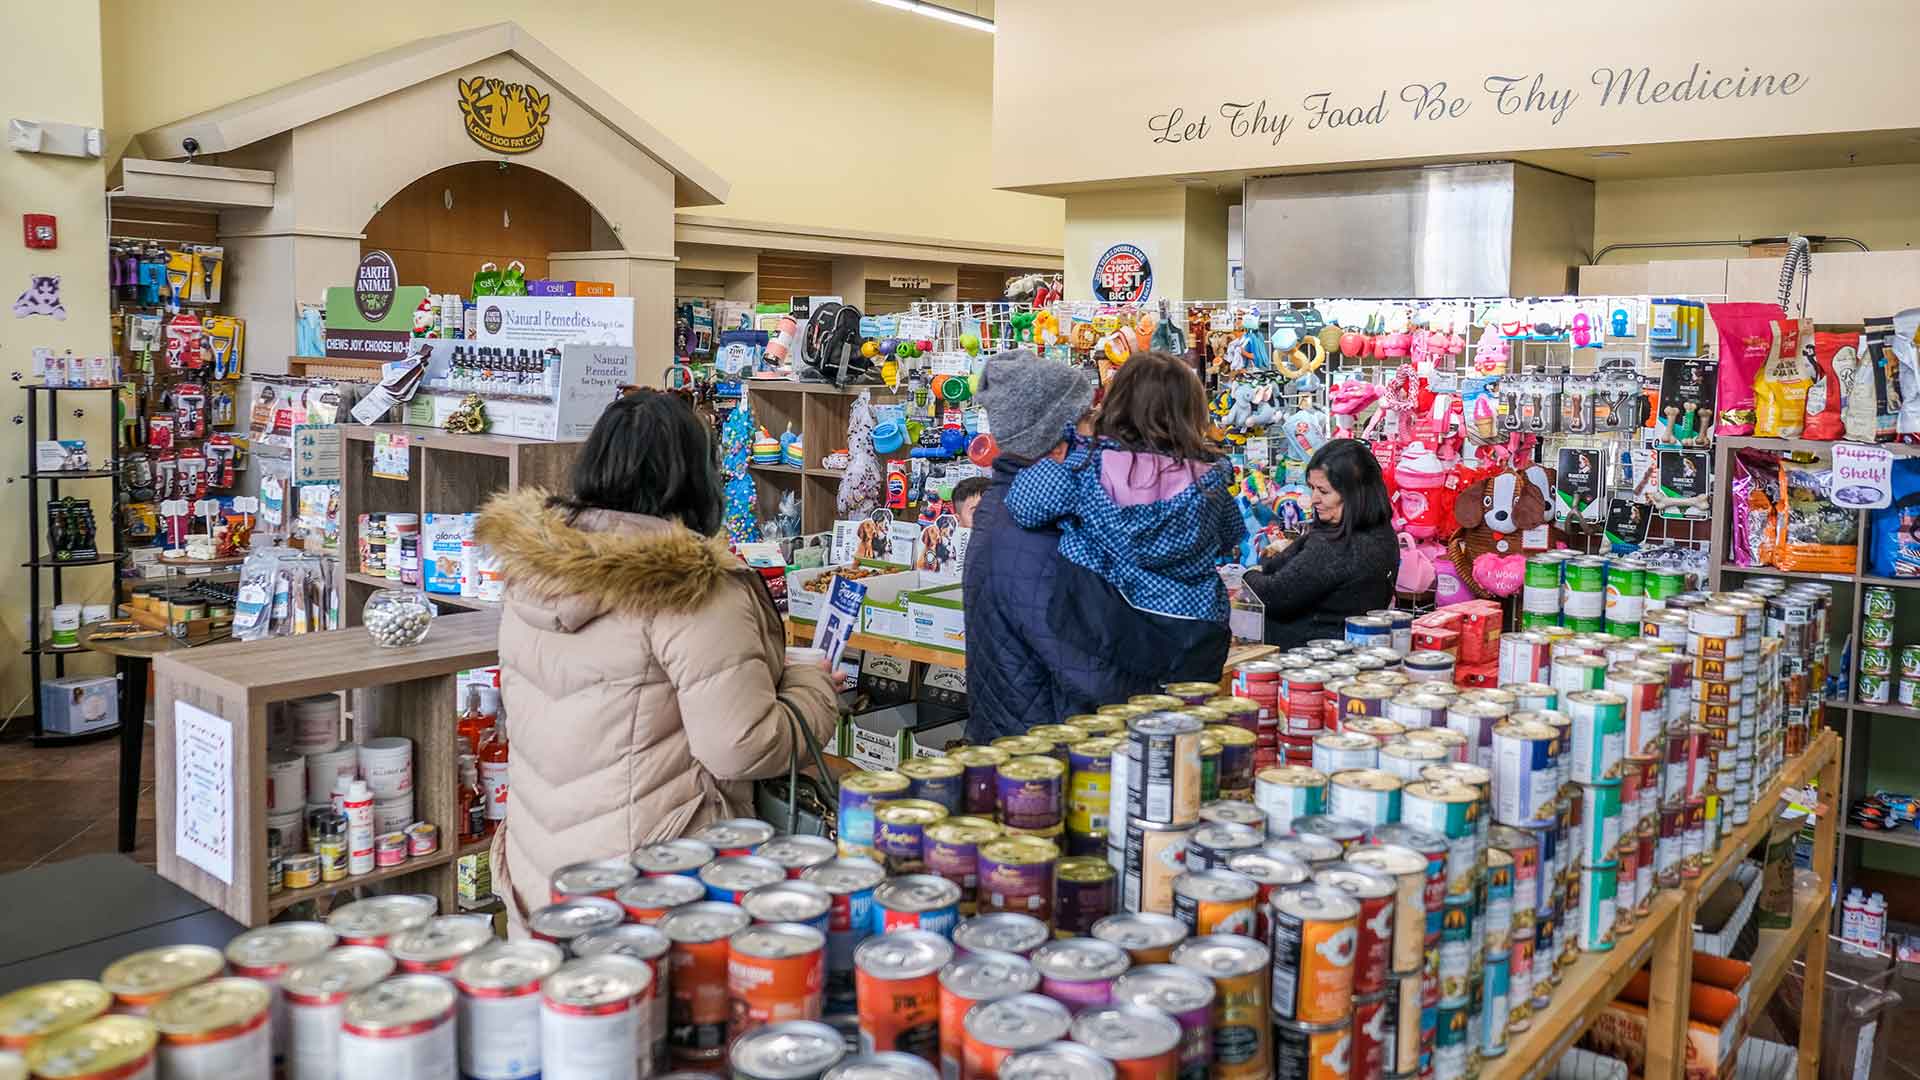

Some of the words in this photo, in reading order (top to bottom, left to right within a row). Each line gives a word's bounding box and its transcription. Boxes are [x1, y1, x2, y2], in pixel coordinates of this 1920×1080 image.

[1149, 107, 1212, 144] Let
[1219, 100, 1294, 146] Thy
[1303, 90, 1392, 130] Food
[1399, 81, 1473, 121] Be
[1483, 72, 1580, 126] Thy
[1591, 63, 1810, 106] Medicine
[470, 123, 491, 141] LONG
[492, 136, 510, 146] DOG
[511, 139, 525, 147] FAT
[525, 134, 540, 145] CAT
[360, 266, 390, 279] EARTH
[1105, 264, 1140, 273] CHOICE
[357, 279, 392, 292] ANIMAL
[1101, 272, 1144, 288] BEST
[1108, 292, 1125, 300] BIG
[1126, 291, 1136, 300] O!
[505, 310, 541, 326] Natural
[545, 310, 591, 328] Remedies
[327, 338, 348, 350] CHEWS
[364, 340, 393, 352] CHOOSE
[593, 353, 628, 365] Natural
[586, 365, 627, 377] Remedies
[1836, 446, 1888, 461] Puppy
[1840, 467, 1887, 482] Shelf!
